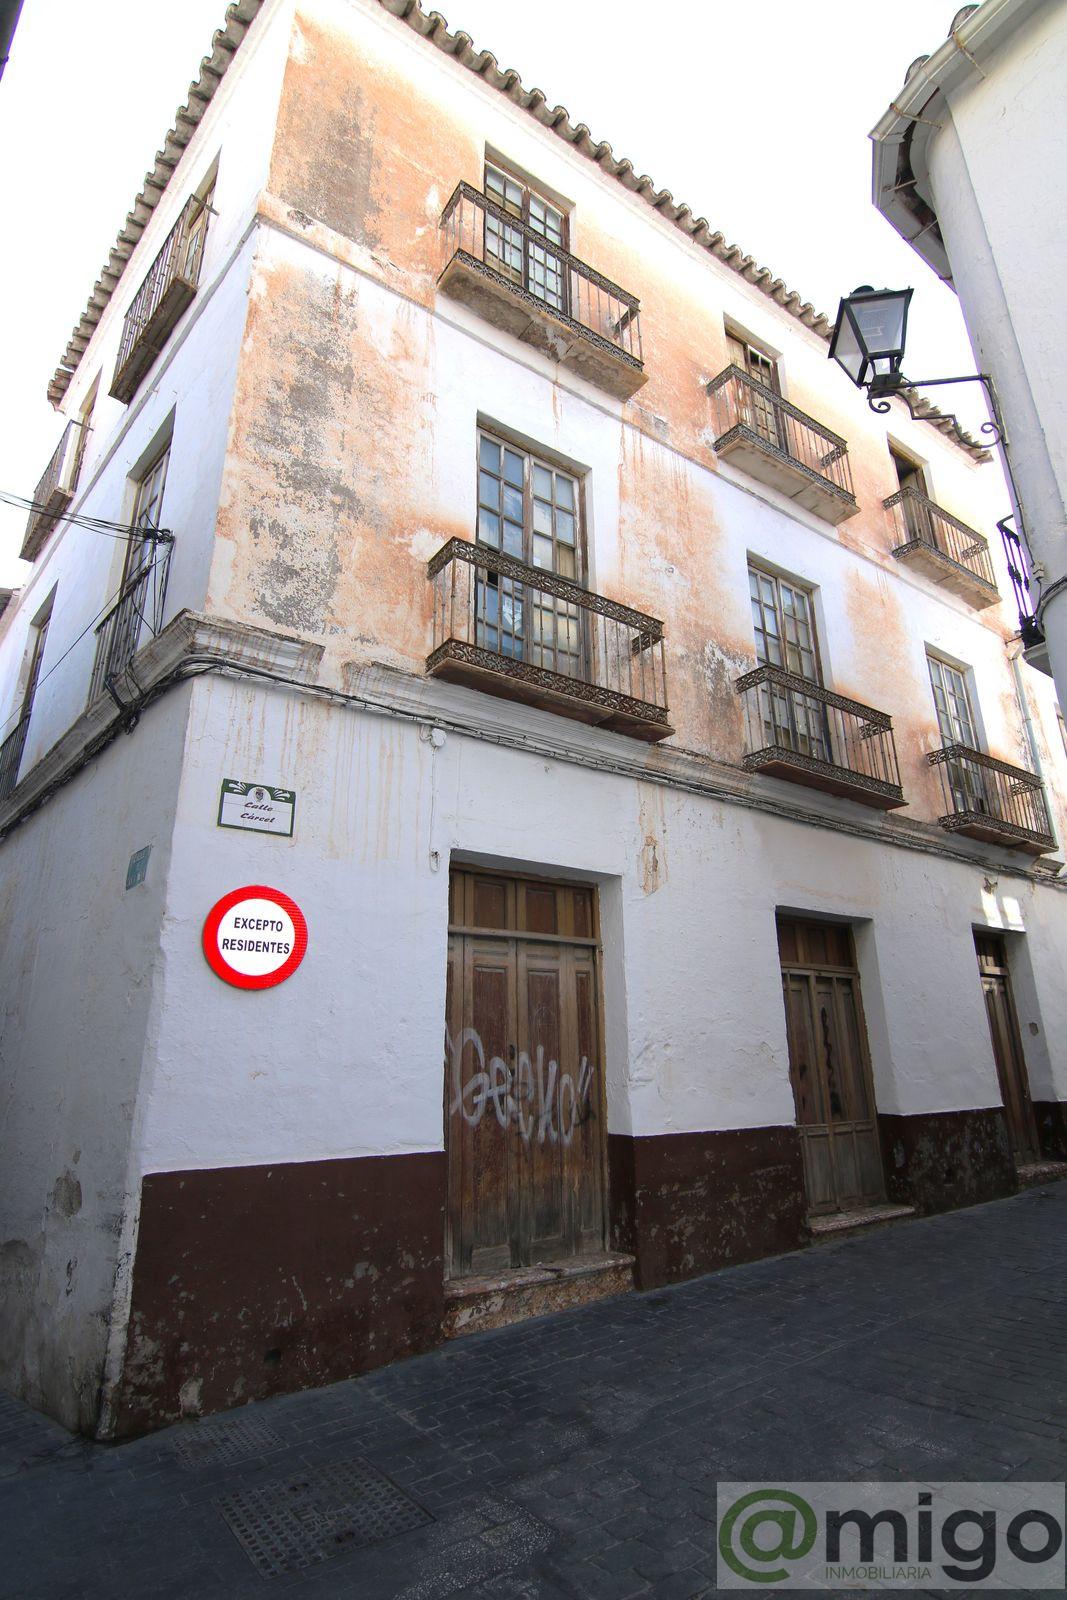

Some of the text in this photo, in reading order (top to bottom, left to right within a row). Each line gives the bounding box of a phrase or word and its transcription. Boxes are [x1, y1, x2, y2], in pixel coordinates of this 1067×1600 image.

[244, 801, 274, 812] Calle
[233, 917, 284, 932] EXCEPTO
[221, 938, 291, 954] RESIDENTES
